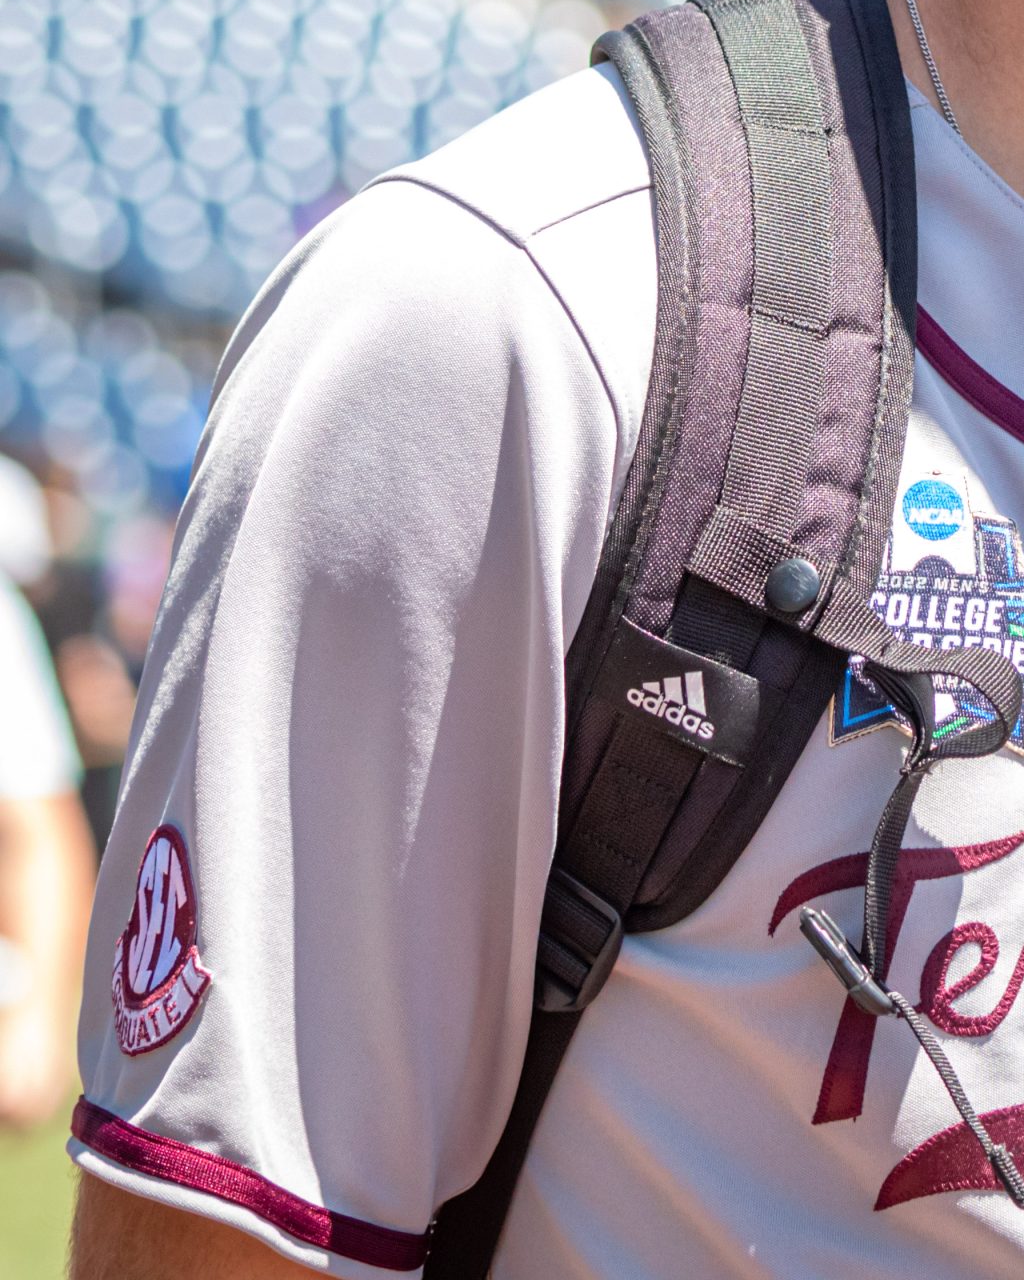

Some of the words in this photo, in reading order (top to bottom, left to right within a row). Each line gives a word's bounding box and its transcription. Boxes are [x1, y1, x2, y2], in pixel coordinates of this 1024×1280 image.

[909, 508, 963, 525] NCAA
[878, 575, 927, 590] 2022
[933, 577, 989, 593] MEN'S
[869, 591, 1004, 633] COLLEGE
[627, 688, 715, 739] adidas
